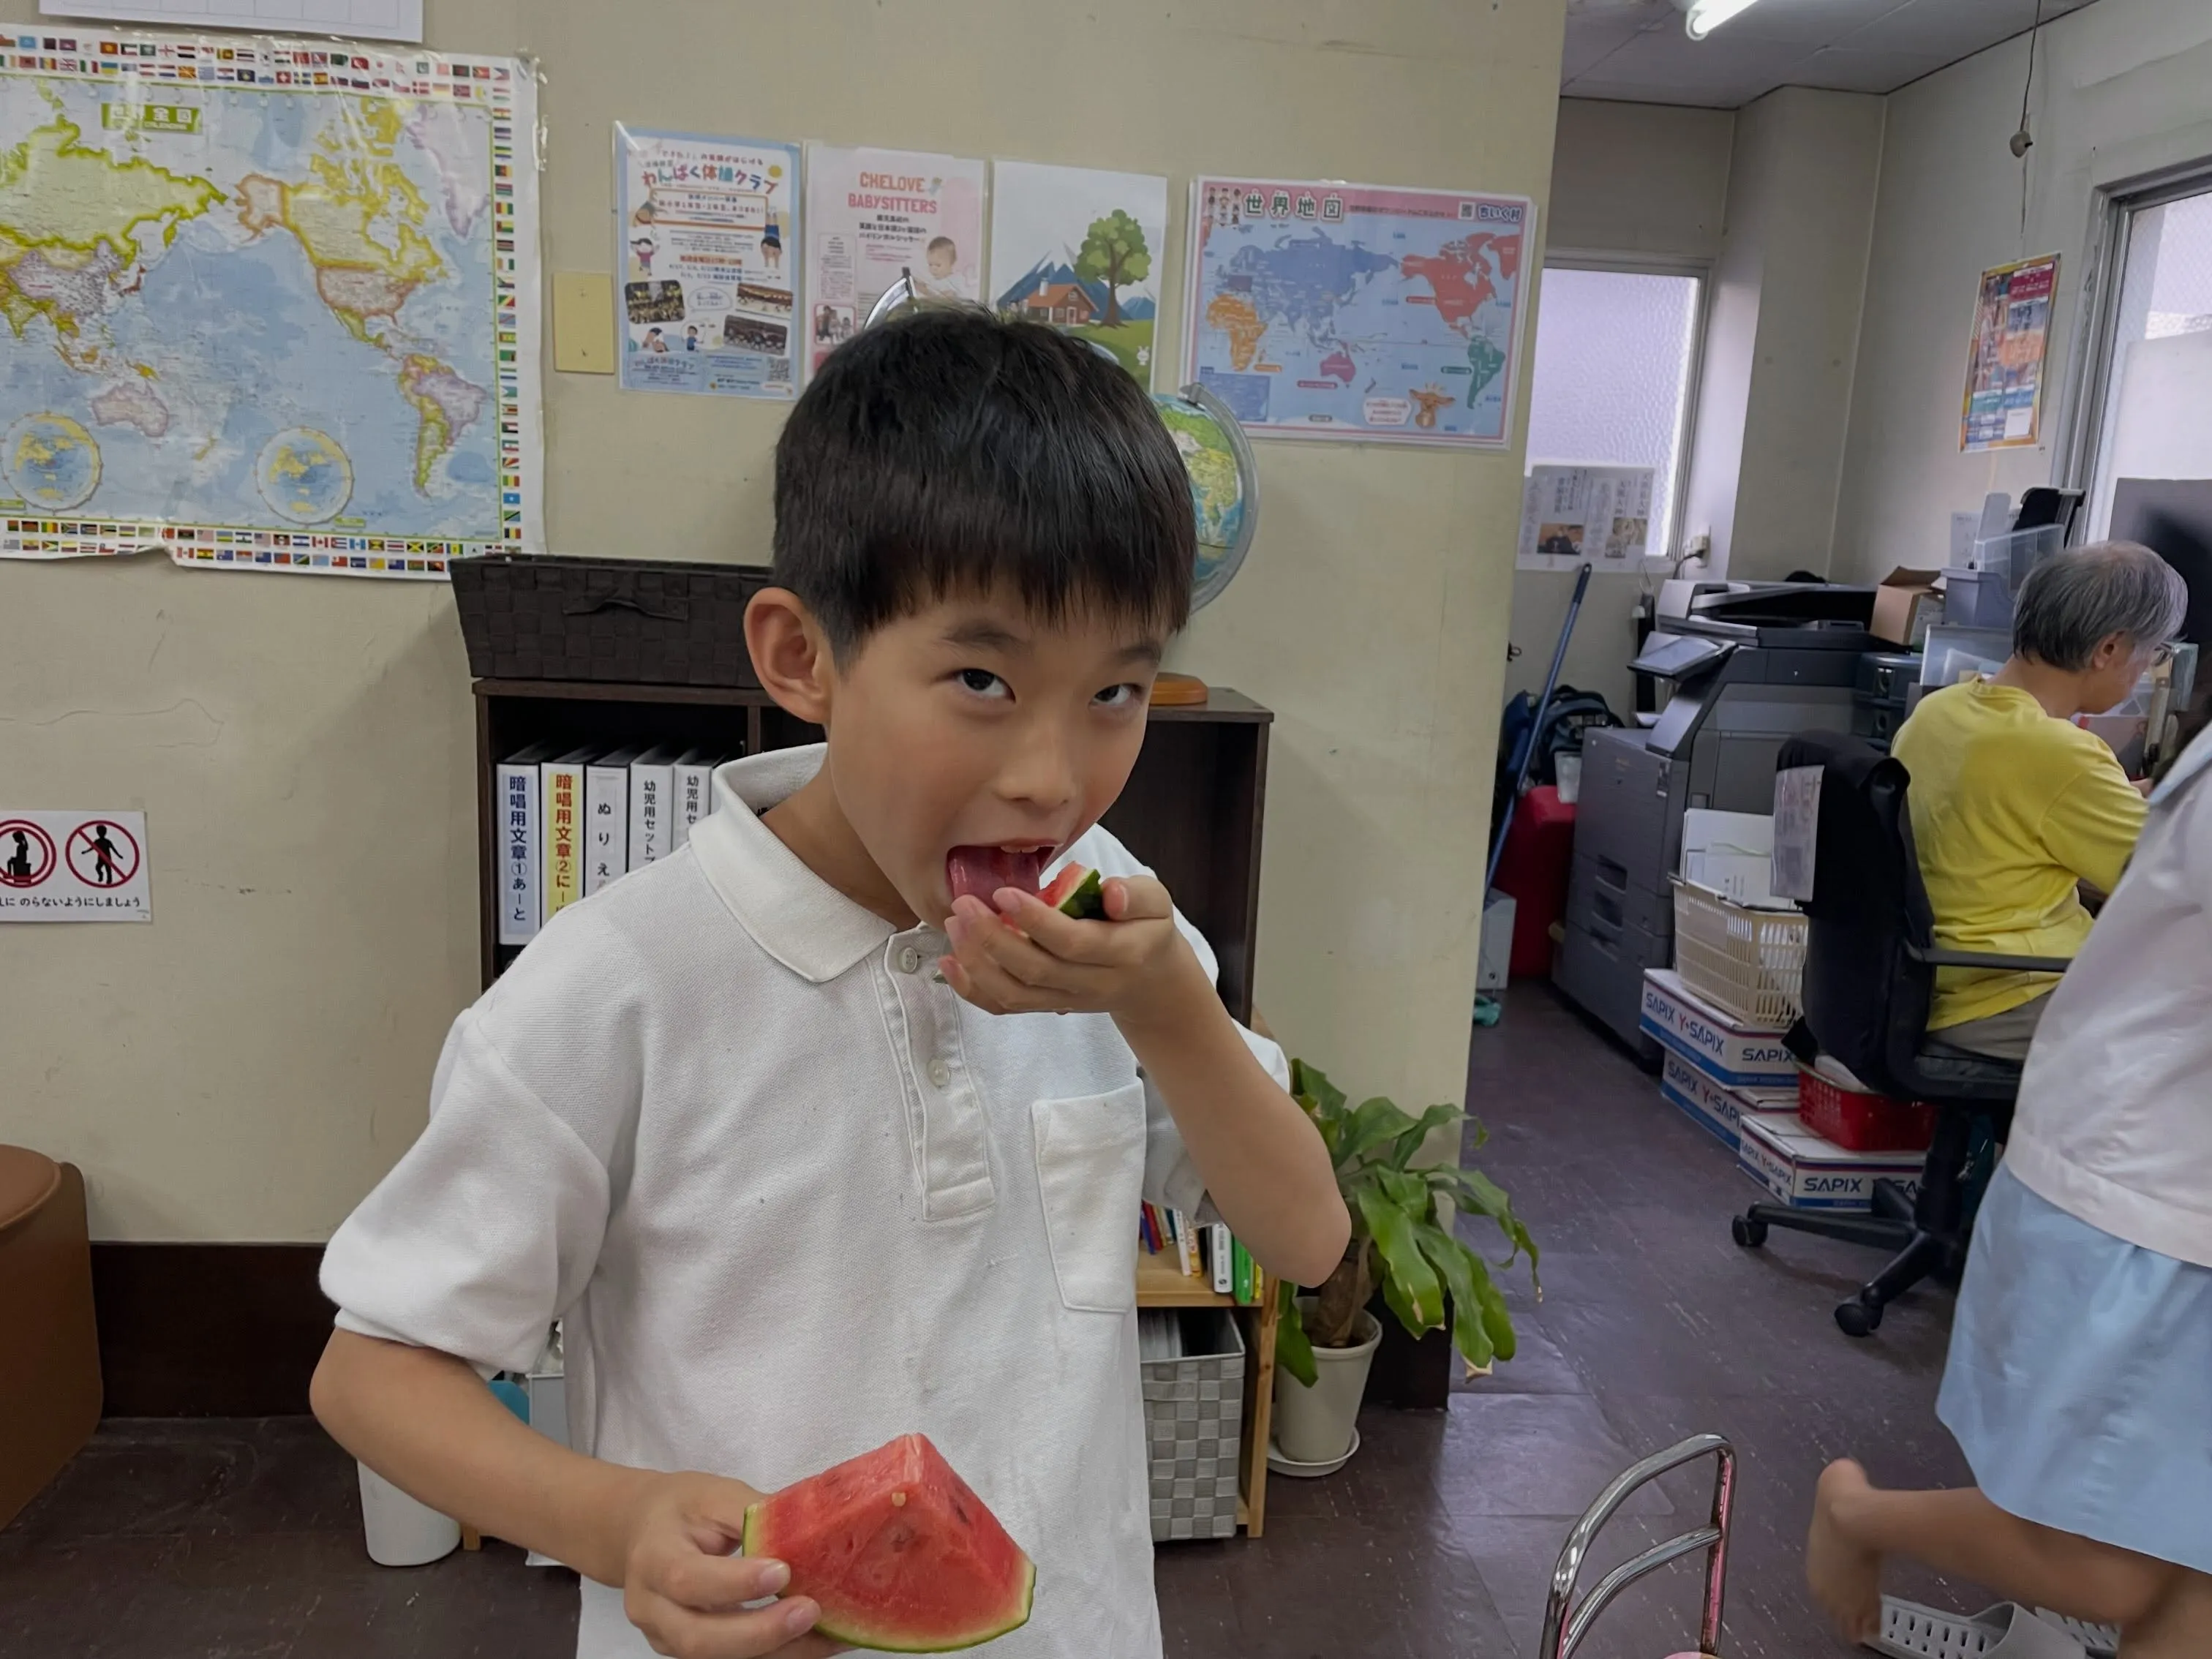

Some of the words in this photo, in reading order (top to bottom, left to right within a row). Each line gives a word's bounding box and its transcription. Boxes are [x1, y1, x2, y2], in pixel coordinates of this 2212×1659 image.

[859, 172, 925, 192] CHELOVE
[848, 192, 937, 214] BABYSITTERS
[1245, 192, 1342, 219] 世界地図
[555, 774, 573, 913] 暗唱用文章②にー
[1646, 993, 1675, 1024] SAPIX
[1742, 1047, 1794, 1062] SAPIX
[1668, 1060, 1698, 1095] SAPIX
[1804, 1177, 1863, 1193] SAPIX
